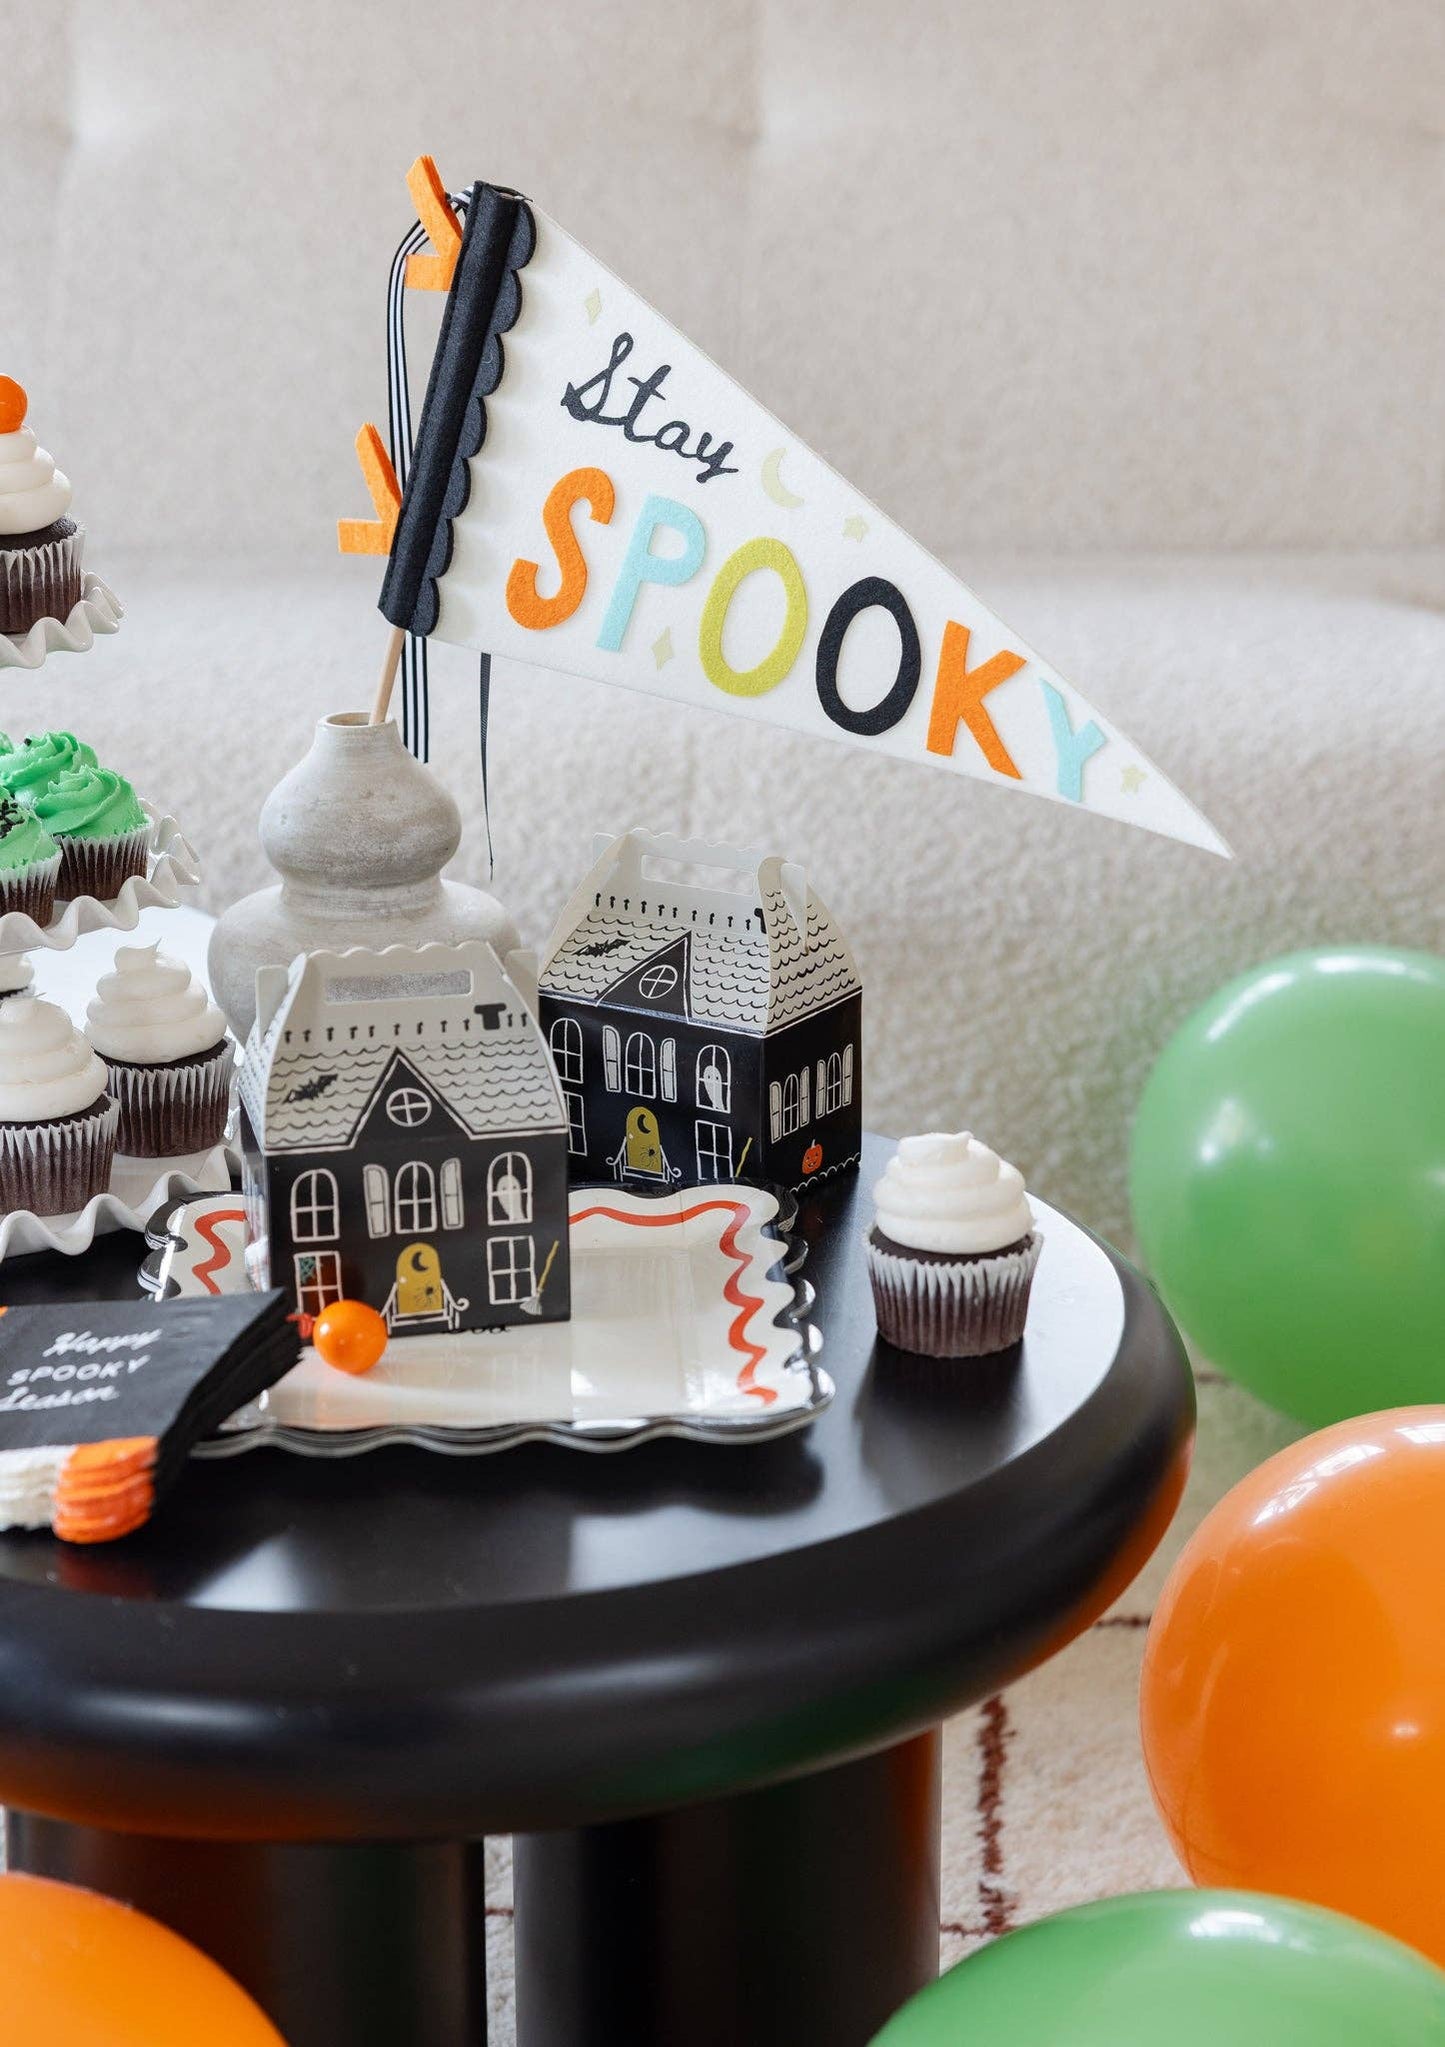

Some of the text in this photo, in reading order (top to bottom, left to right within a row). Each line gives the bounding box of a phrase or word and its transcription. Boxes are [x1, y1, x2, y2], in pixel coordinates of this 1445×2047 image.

[560, 332, 739, 483] Stay
[506, 467, 1107, 803] SPOOKY
[6, 1355, 151, 1386] SPOOKY
